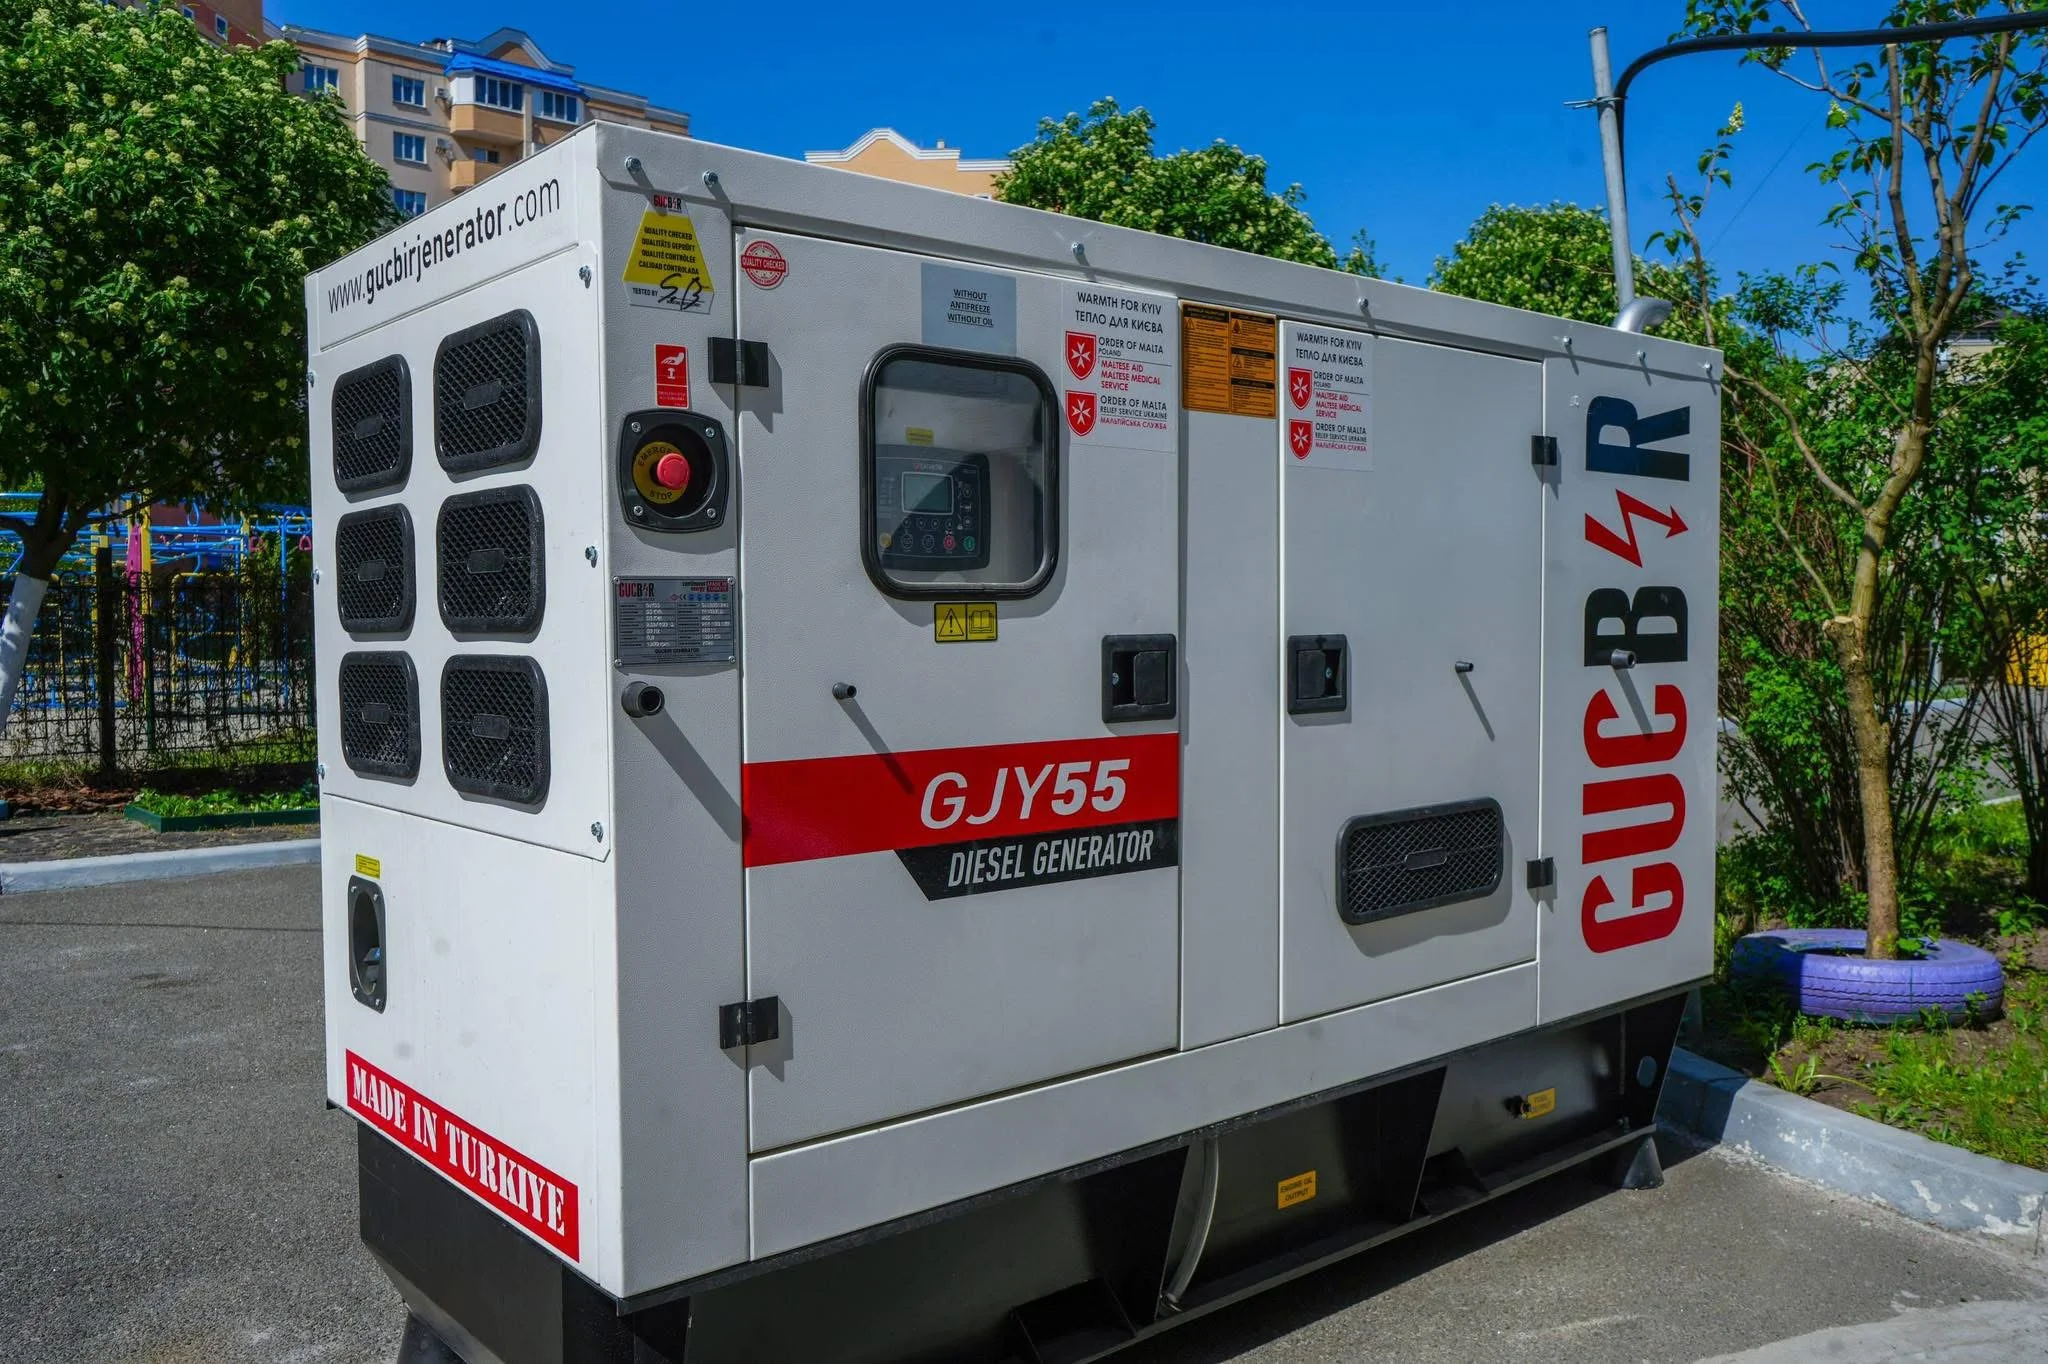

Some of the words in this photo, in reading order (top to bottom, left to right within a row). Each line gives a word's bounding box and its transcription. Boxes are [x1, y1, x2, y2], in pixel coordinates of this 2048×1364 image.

[644, 226, 668, 237] QUALITY
[668, 231, 693, 240] CHECKED
[328, 178, 560, 314] www.gucbirjenerator.com
[641, 238, 671, 249] QUALITÄTS
[641, 249, 665, 260] QUALITÉ
[638, 261, 662, 271] CALIDAD
[663, 264, 699, 274] CONTROLADA
[742, 257, 763, 268] QUALITY
[632, 287, 651, 296] TESTED
[651, 289, 659, 297] BY
[953, 289, 987, 300] WITHOUT
[950, 300, 991, 313] ANTIFREEZE
[1077, 291, 1118, 308] WARMTH
[1121, 299, 1139, 312] FOR
[1141, 303, 1162, 315] KYIV
[947, 312, 981, 324] WITHOUT
[1075, 310, 1107, 325] ТЕПЛО
[1109, 316, 1129, 328] ДЛЯ
[1132, 320, 1164, 334] КИЄВА
[1098, 336, 1125, 349] ORDER
[1126, 341, 1137, 350] OF
[1138, 343, 1164, 354] MALTA
[1296, 331, 1328, 345] WARMTH
[1330, 337, 1345, 348] FOR
[1346, 340, 1363, 351] KYIV
[1098, 348, 1121, 357] POLAND
[1295, 348, 1320, 361] ТЕПЛО
[1321, 353, 1337, 363] ДЛЯ
[1339, 355, 1364, 367] КИЄВА
[1101, 360, 1130, 371] MALTESE
[1131, 364, 1144, 373] AID
[1101, 370, 1130, 381] MALTESE
[1131, 375, 1161, 385] MEDICAL
[1313, 371, 1334, 381] ORDER
[1334, 374, 1343, 382] OF
[1344, 375, 1364, 385] MALTA
[1313, 380, 1331, 388] POLAND
[1101, 381, 1129, 391] SERVICE
[1100, 395, 1127, 406] ORDER
[1128, 398, 1140, 408] OF
[1141, 400, 1167, 410] MALTA
[1315, 391, 1338, 401] MALTESE
[1339, 394, 1348, 402] AID
[1100, 406, 1117, 414] RELIEF
[1119, 408, 1142, 417] SERVICE
[1143, 410, 1167, 419] UKRAINE
[1315, 401, 1338, 410] MALTESE
[1339, 403, 1362, 412] MEDICAL
[1315, 409, 1337, 419] SERVICE
[1142, 421, 1167, 430] СЛУЖБА
[1315, 422, 1336, 432] ORDER
[1337, 425, 1346, 433] OF
[1347, 426, 1367, 435] MALTA
[649, 490, 673, 501] STOP
[920, 758, 1131, 829] GJY55
[948, 844, 1026, 888] DIESEL
[1032, 829, 1154, 876] GENERATOR
[351, 1061, 407, 1133] MADE
[412, 1101, 438, 1153] IN
[444, 1119, 565, 1237] TURKIYE
